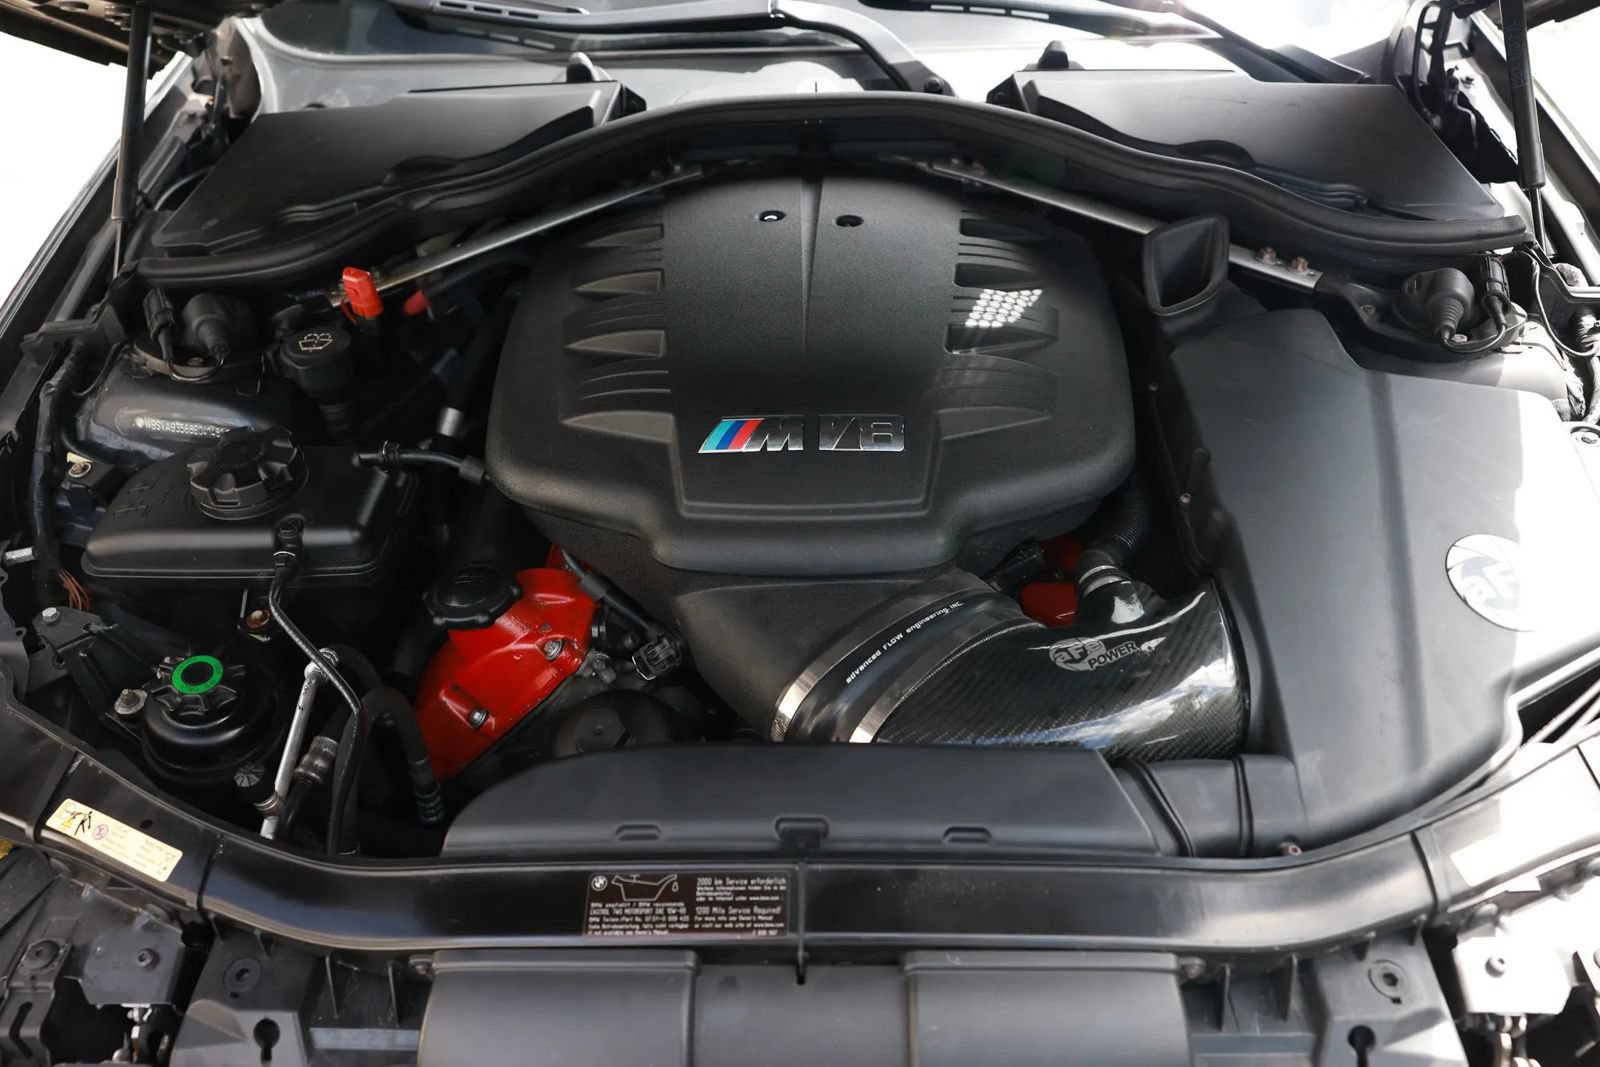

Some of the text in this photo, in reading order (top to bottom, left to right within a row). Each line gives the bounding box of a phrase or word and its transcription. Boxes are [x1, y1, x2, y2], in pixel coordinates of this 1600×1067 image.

[819, 415, 905, 452] V8
[846, 650, 882, 684] advanced
[882, 633, 904, 651] FLOW
[1086, 641, 1138, 671] POWER
[697, 877, 713, 886] 2000
[725, 877, 748, 886] Service
[750, 877, 787, 886] erforderlich
[712, 906, 726, 915] Mile
[728, 906, 751, 915] Service
